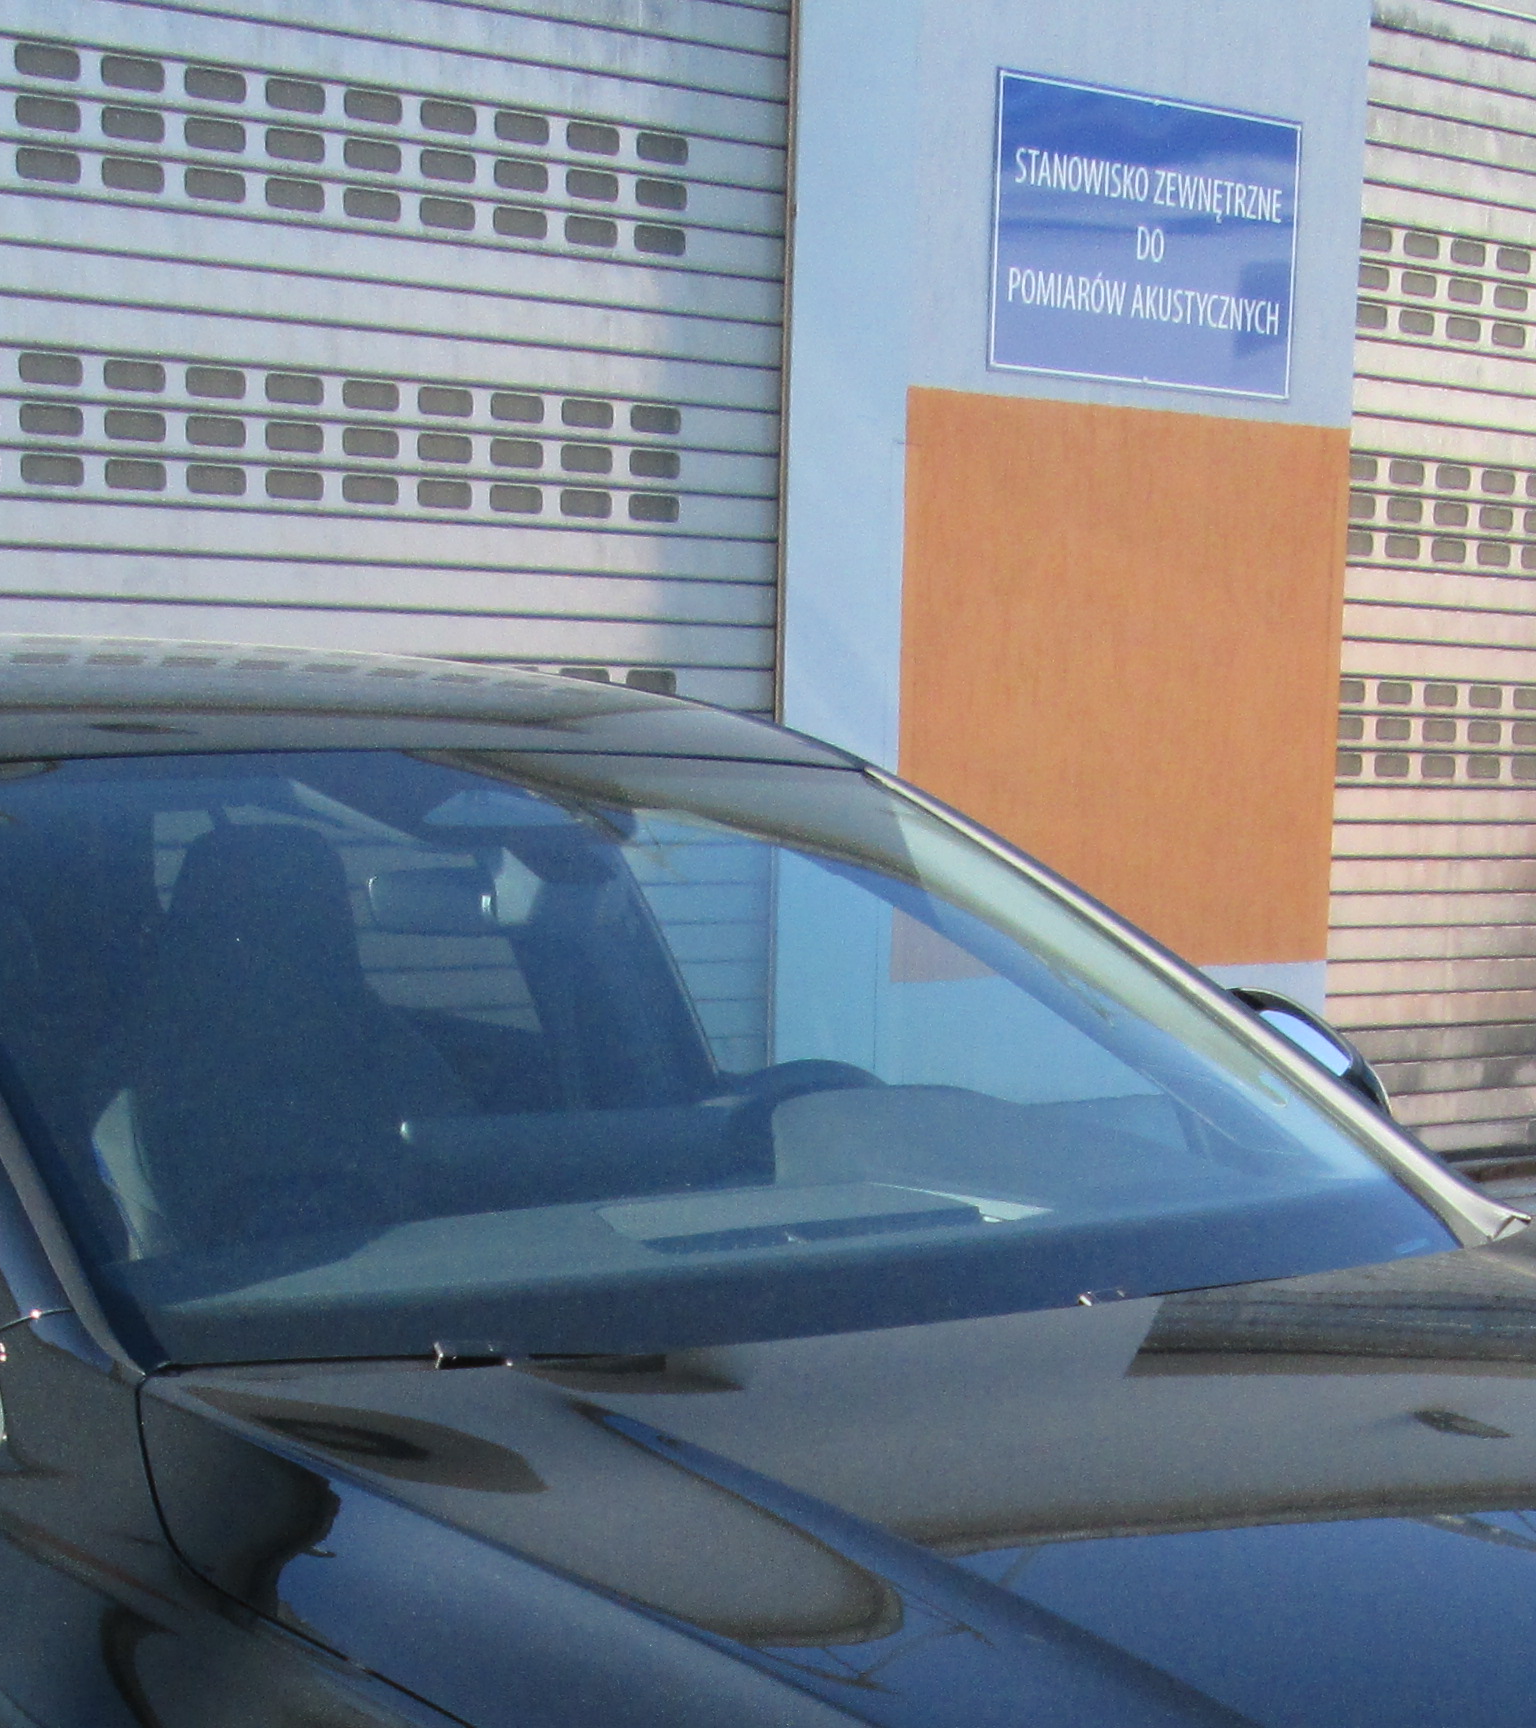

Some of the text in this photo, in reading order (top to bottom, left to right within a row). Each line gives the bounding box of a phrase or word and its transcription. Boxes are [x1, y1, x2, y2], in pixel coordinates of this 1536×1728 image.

[1014, 147, 1283, 224] STANOWISKO ZEWNĘTRZNE
[1136, 226, 1165, 263] DO
[1007, 266, 1280, 335] POMIARÓW AKUSTYCZNYCH
